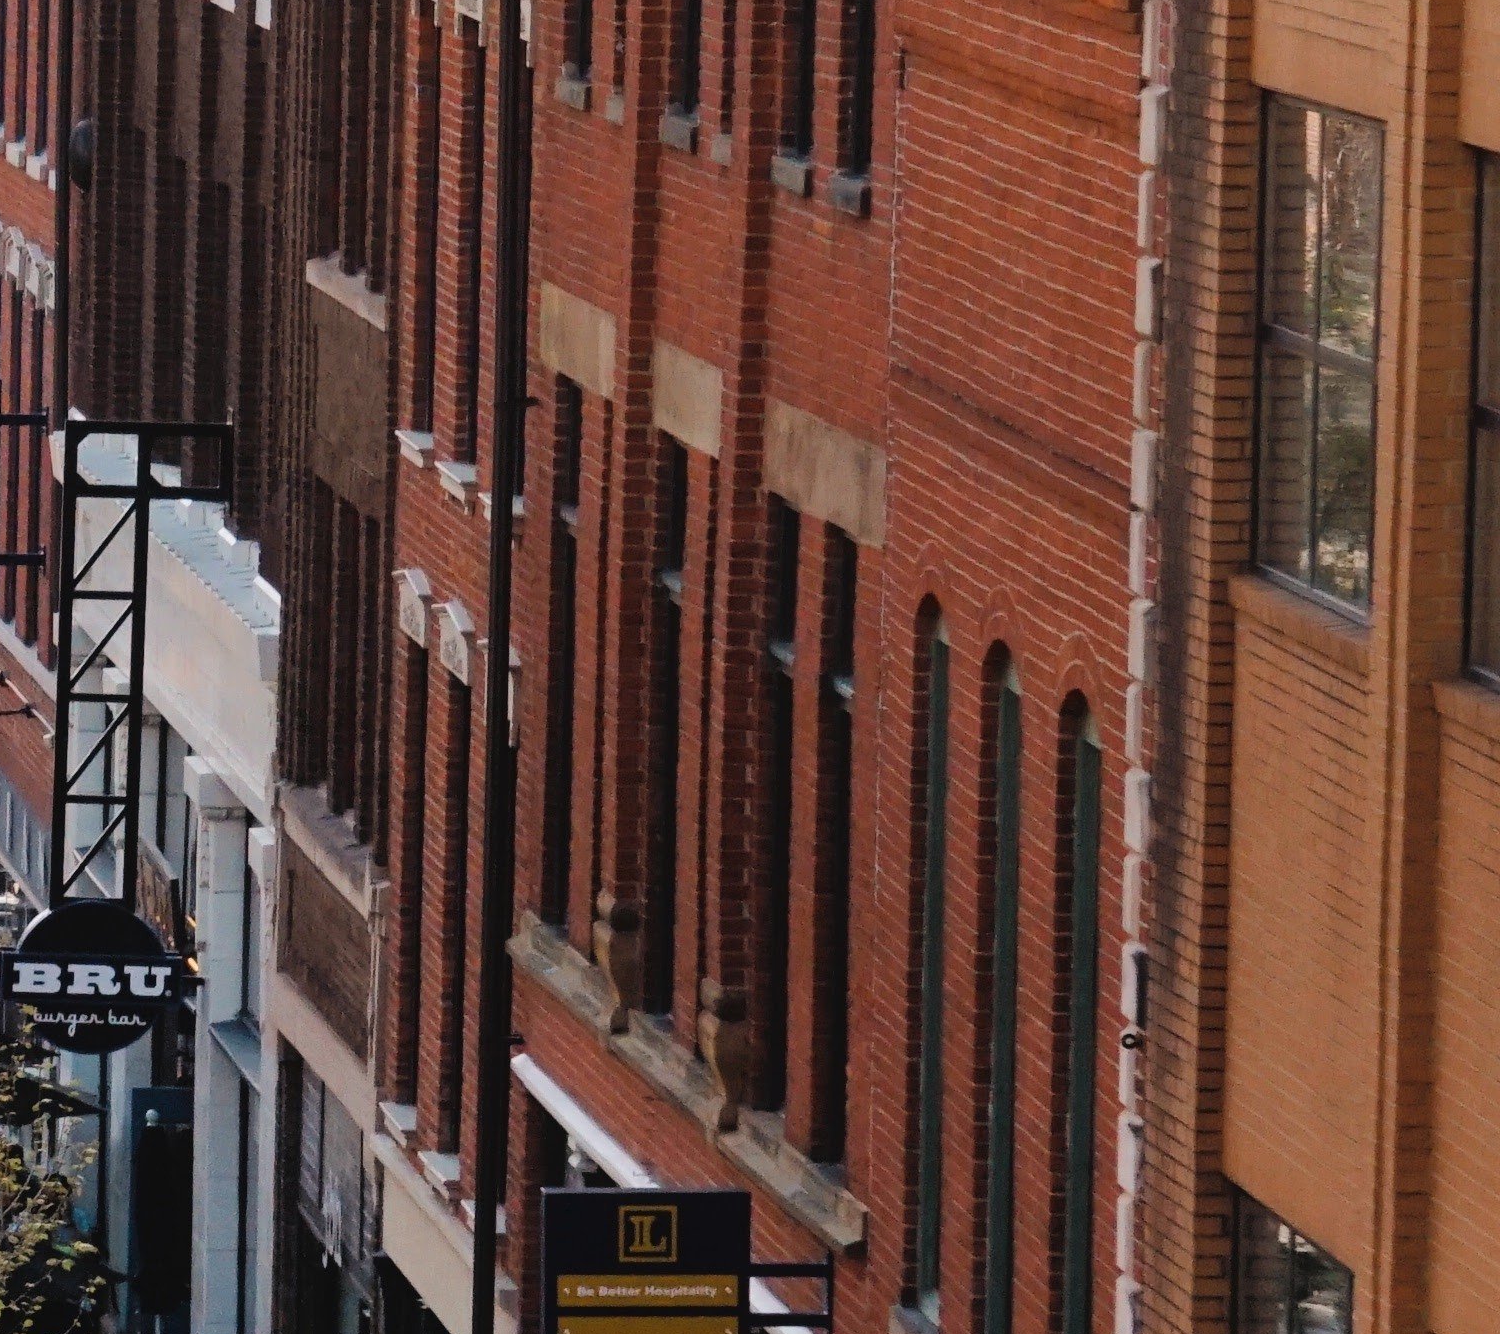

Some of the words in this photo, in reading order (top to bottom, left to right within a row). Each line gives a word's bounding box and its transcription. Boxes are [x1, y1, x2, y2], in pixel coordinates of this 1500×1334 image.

[108, 1009, 147, 1027] bar
[598, 1285, 641, 1297] Better
[644, 1284, 718, 1299] Hospitality
